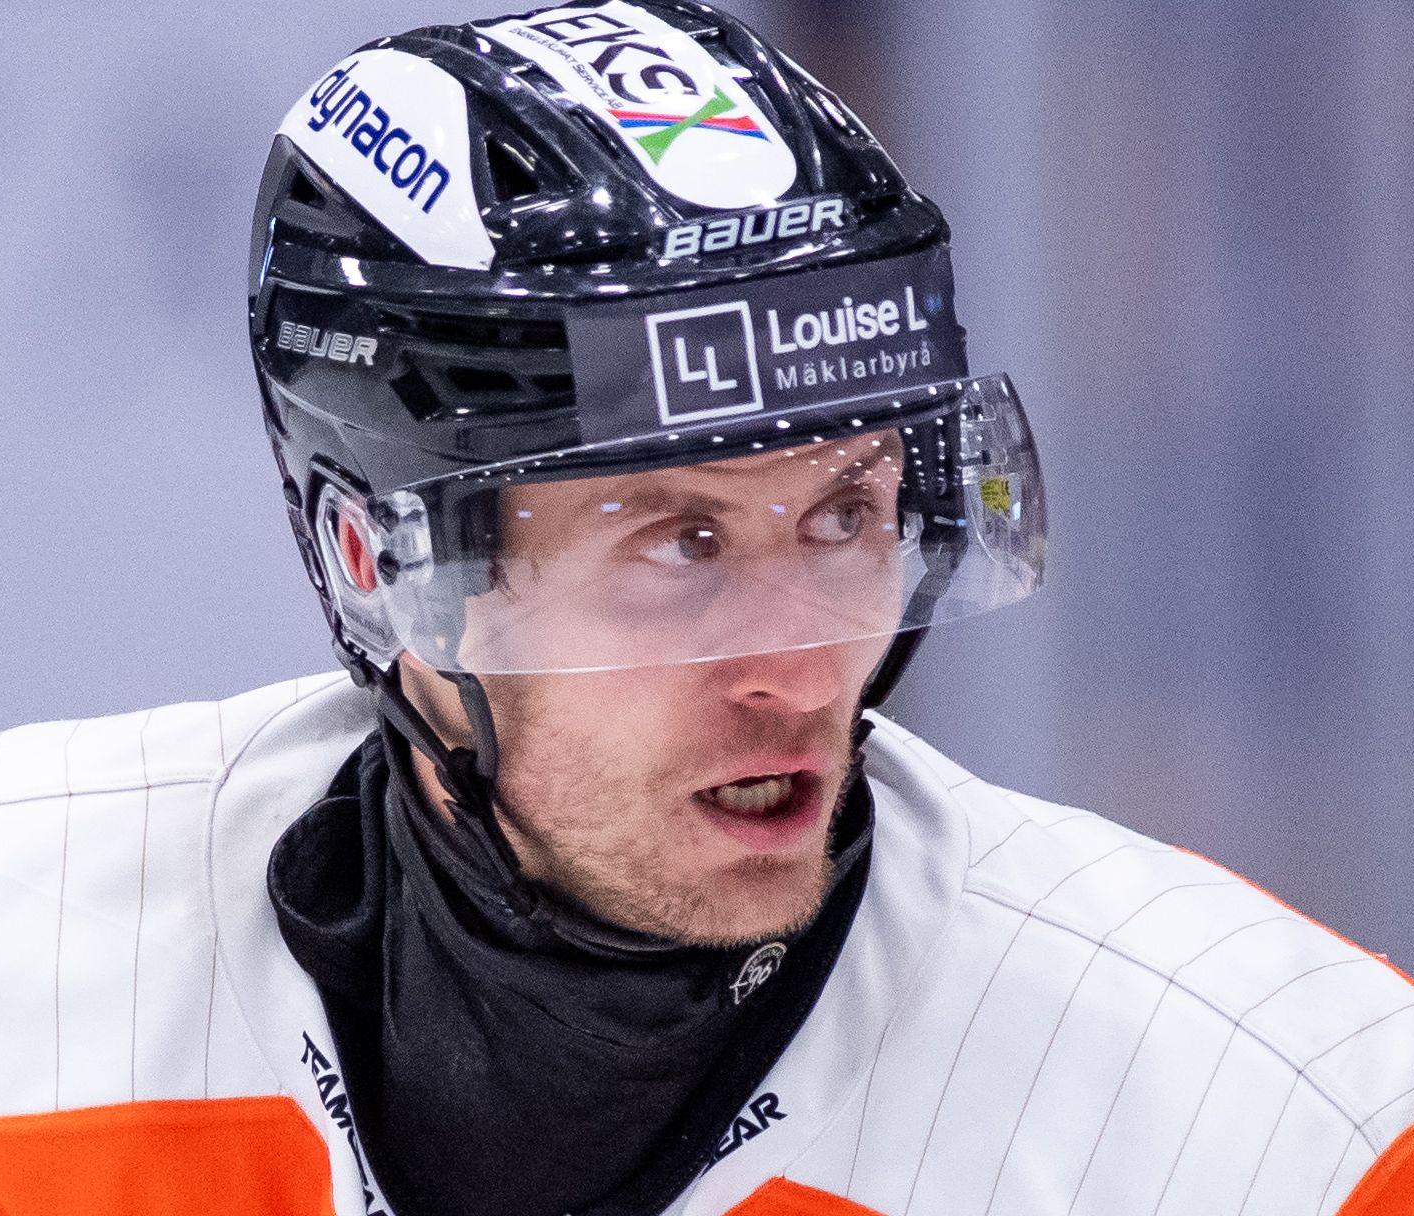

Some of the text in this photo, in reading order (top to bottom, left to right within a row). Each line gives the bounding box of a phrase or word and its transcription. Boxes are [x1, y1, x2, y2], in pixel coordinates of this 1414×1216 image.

[526, 12, 701, 104] EKS
[307, 60, 451, 215] dynacon
[767, 296, 901, 355] Louise
[774, 340, 932, 391] Mäklarbyrå
